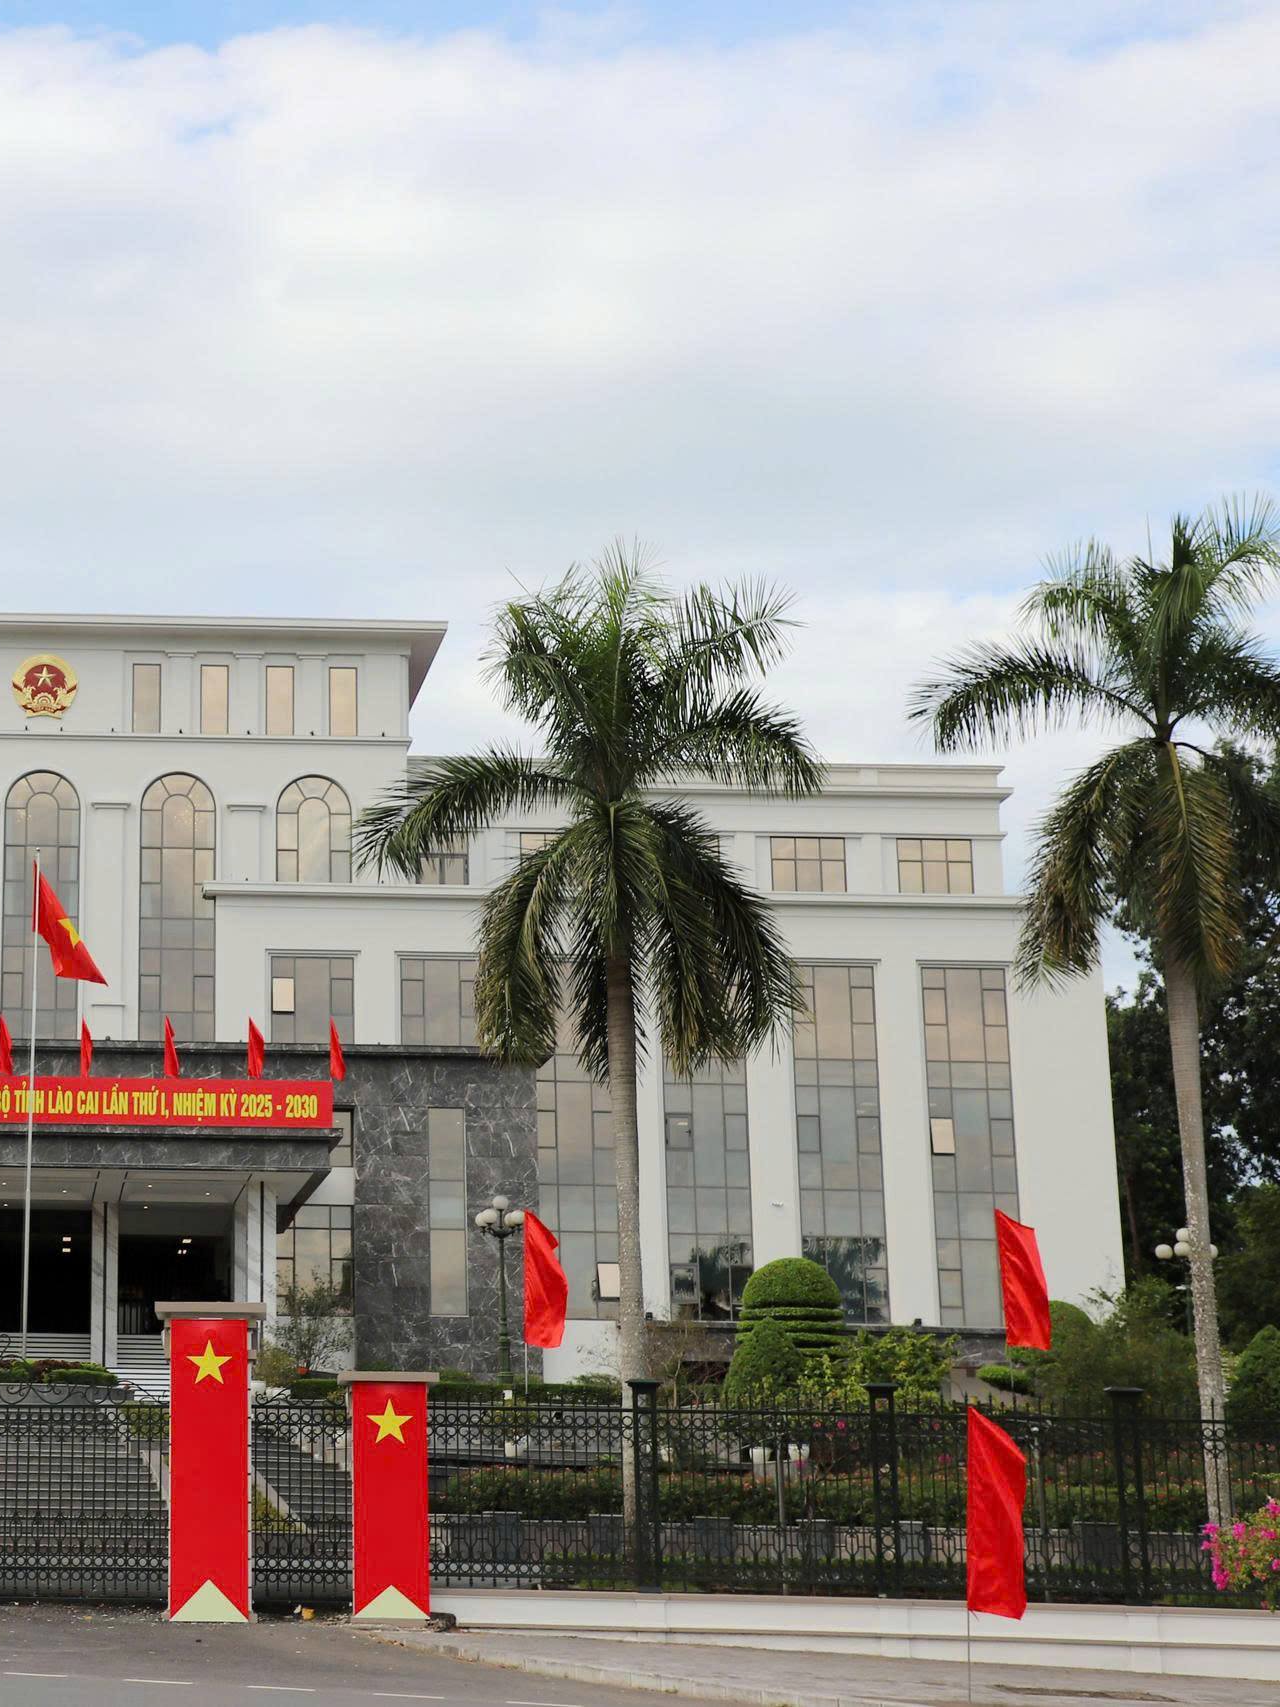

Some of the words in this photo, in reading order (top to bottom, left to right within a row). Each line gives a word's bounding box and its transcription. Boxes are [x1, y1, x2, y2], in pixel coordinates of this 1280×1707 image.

[48, 1085, 73, 1114] LÀO
[76, 1090, 99, 1115] CAI
[102, 1083, 129, 1115] LẦN
[132, 1085, 159, 1115] THỨ
[161, 1092, 169, 1119] I,
[173, 1087, 216, 1122] NHIỆM
[220, 1088, 237, 1117] KỲ
[240, 1093, 273, 1118] 2025
[285, 1094, 318, 1118] 2030
